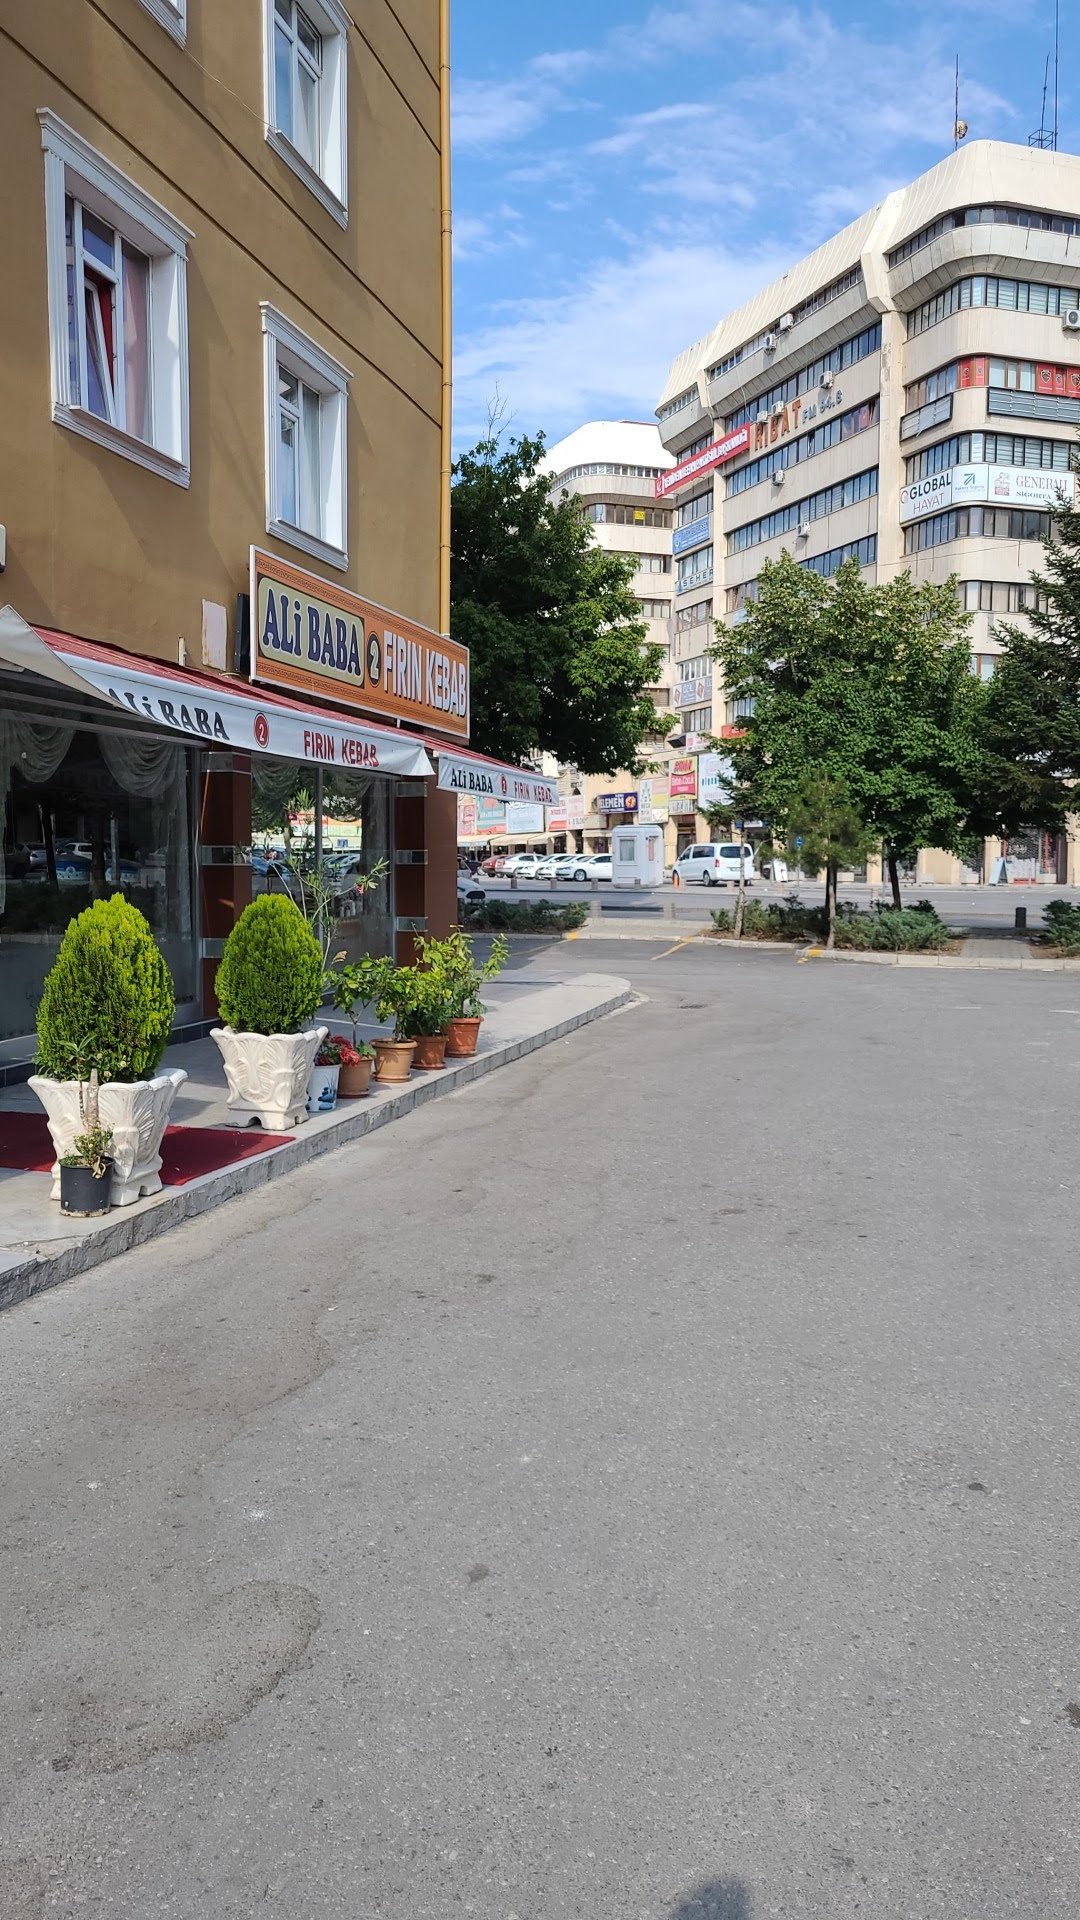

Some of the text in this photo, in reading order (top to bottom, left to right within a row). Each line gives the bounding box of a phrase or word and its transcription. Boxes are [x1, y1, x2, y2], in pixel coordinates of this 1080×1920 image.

[755, 399, 801, 452] RIBAT
[802, 404, 817, 424] FM
[909, 473, 951, 500] GLOBAL
[1016, 475, 1068, 492] GENERALI
[913, 493, 944, 515] HAYAT
[307, 606, 362, 677] BABA
[369, 639, 379, 680] 2
[383, 630, 423, 704] FIRIN
[425, 648, 467, 717] KEBAB
[158, 699, 230, 741] BABA
[259, 723, 265, 742] 2
[303, 730, 335, 761] FIRIN
[341, 738, 380, 767] KEBAB
[468, 772, 494, 793] BABA
[513, 781, 530, 800] FIRIN
[533, 785, 553, 803] KEBAB
